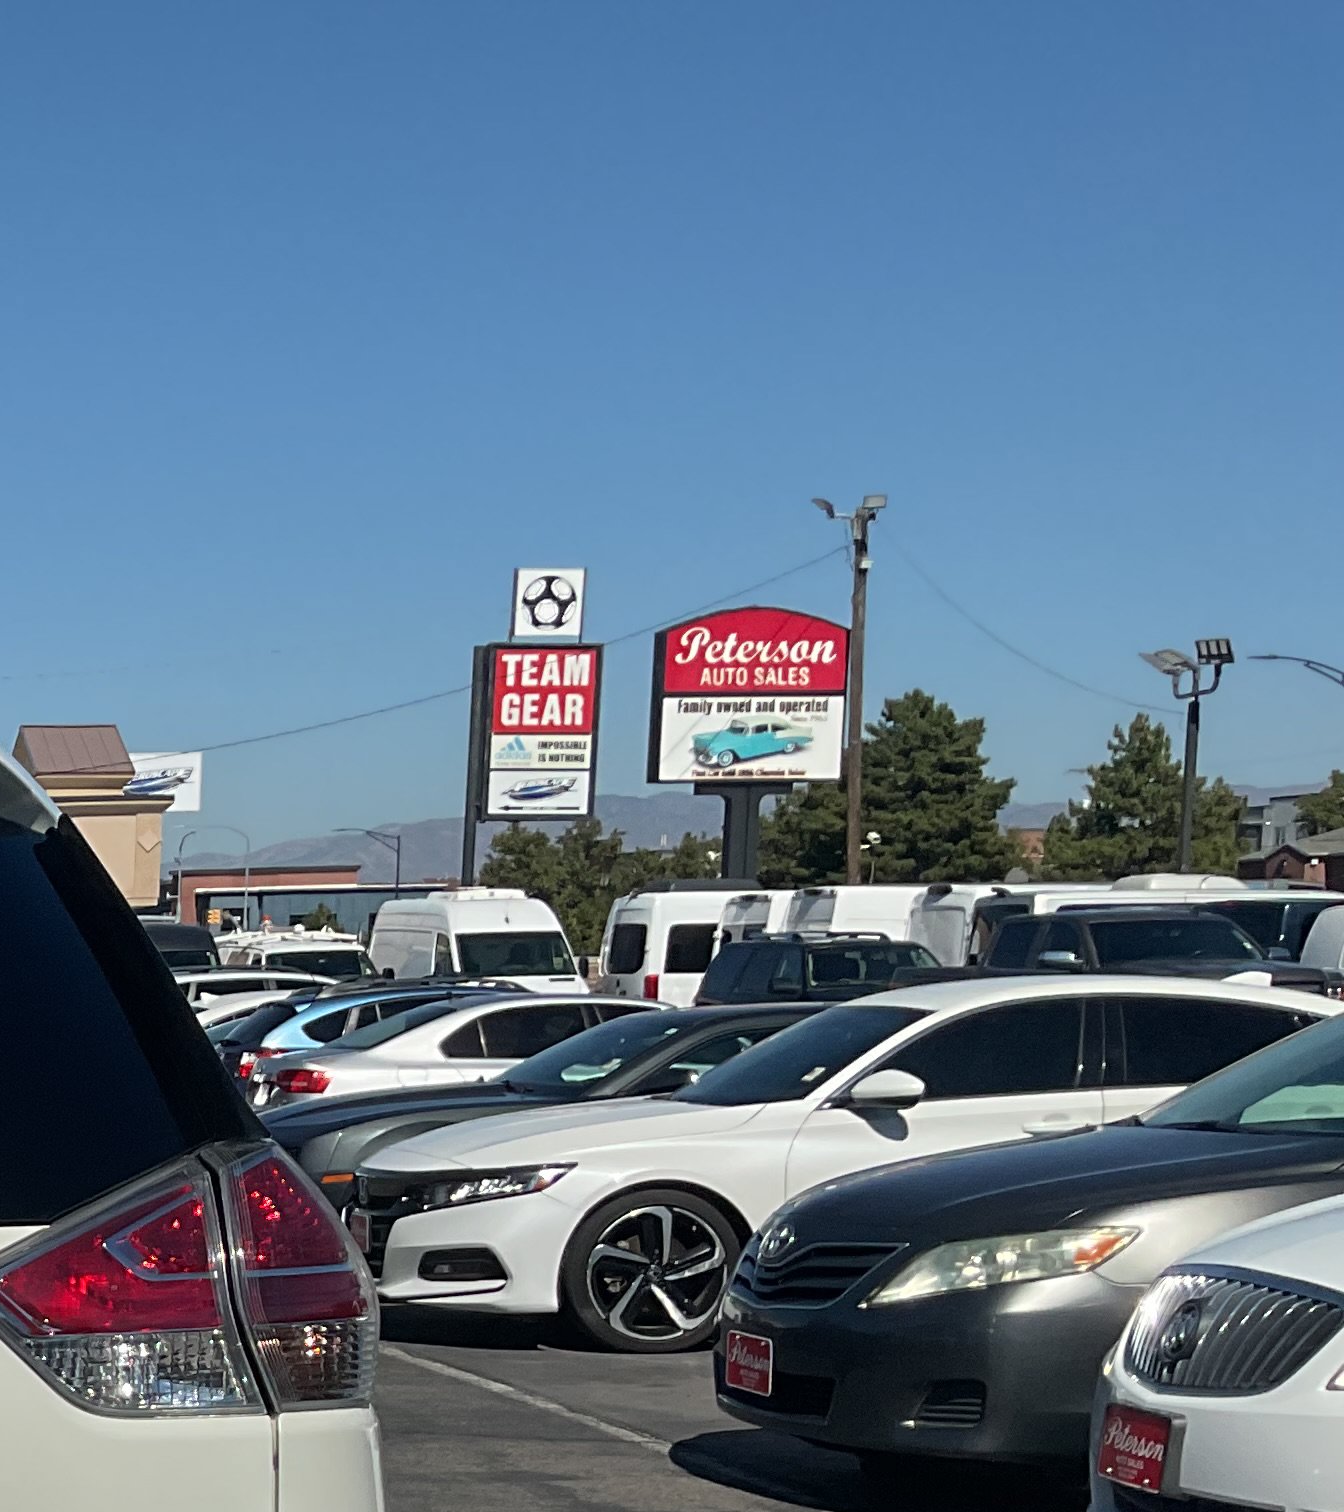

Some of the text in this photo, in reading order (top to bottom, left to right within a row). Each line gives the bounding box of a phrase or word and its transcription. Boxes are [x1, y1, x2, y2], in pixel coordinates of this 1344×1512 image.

[674, 626, 837, 665] Peterson
[501, 653, 591, 687] TEAM
[700, 667, 811, 687] AUTO SALES
[500, 692, 585, 727] GEAR
[677, 698, 829, 715] Family owned and operated
[537, 741, 587, 750] IMPOSSIBLE
[537, 753, 585, 763] IS NOTHING
[1104, 1415, 1165, 1462] Peterson
